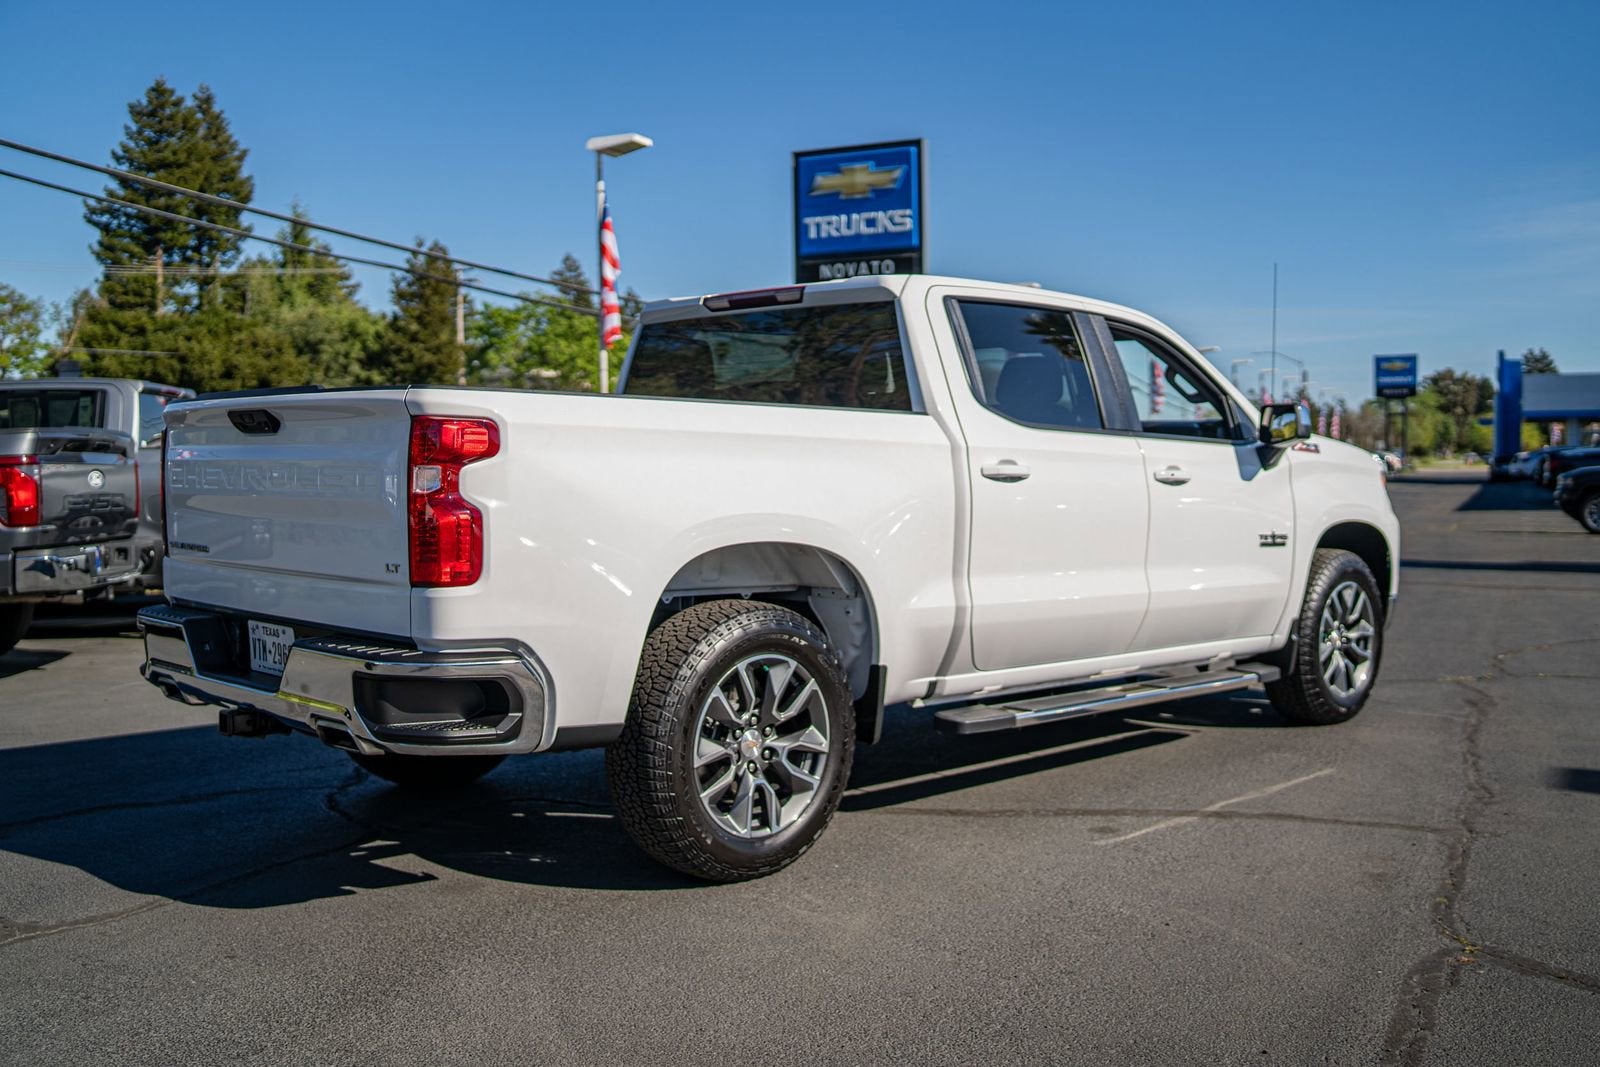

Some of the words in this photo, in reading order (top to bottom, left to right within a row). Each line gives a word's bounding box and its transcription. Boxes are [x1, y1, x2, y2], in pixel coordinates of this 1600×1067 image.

[803, 209, 913, 239] TRUCKS
[819, 259, 896, 279] NOVATO
[169, 464, 377, 493] CHEVROLET
[385, 563, 401, 574] LT
[262, 625, 280, 638] TEXAS
